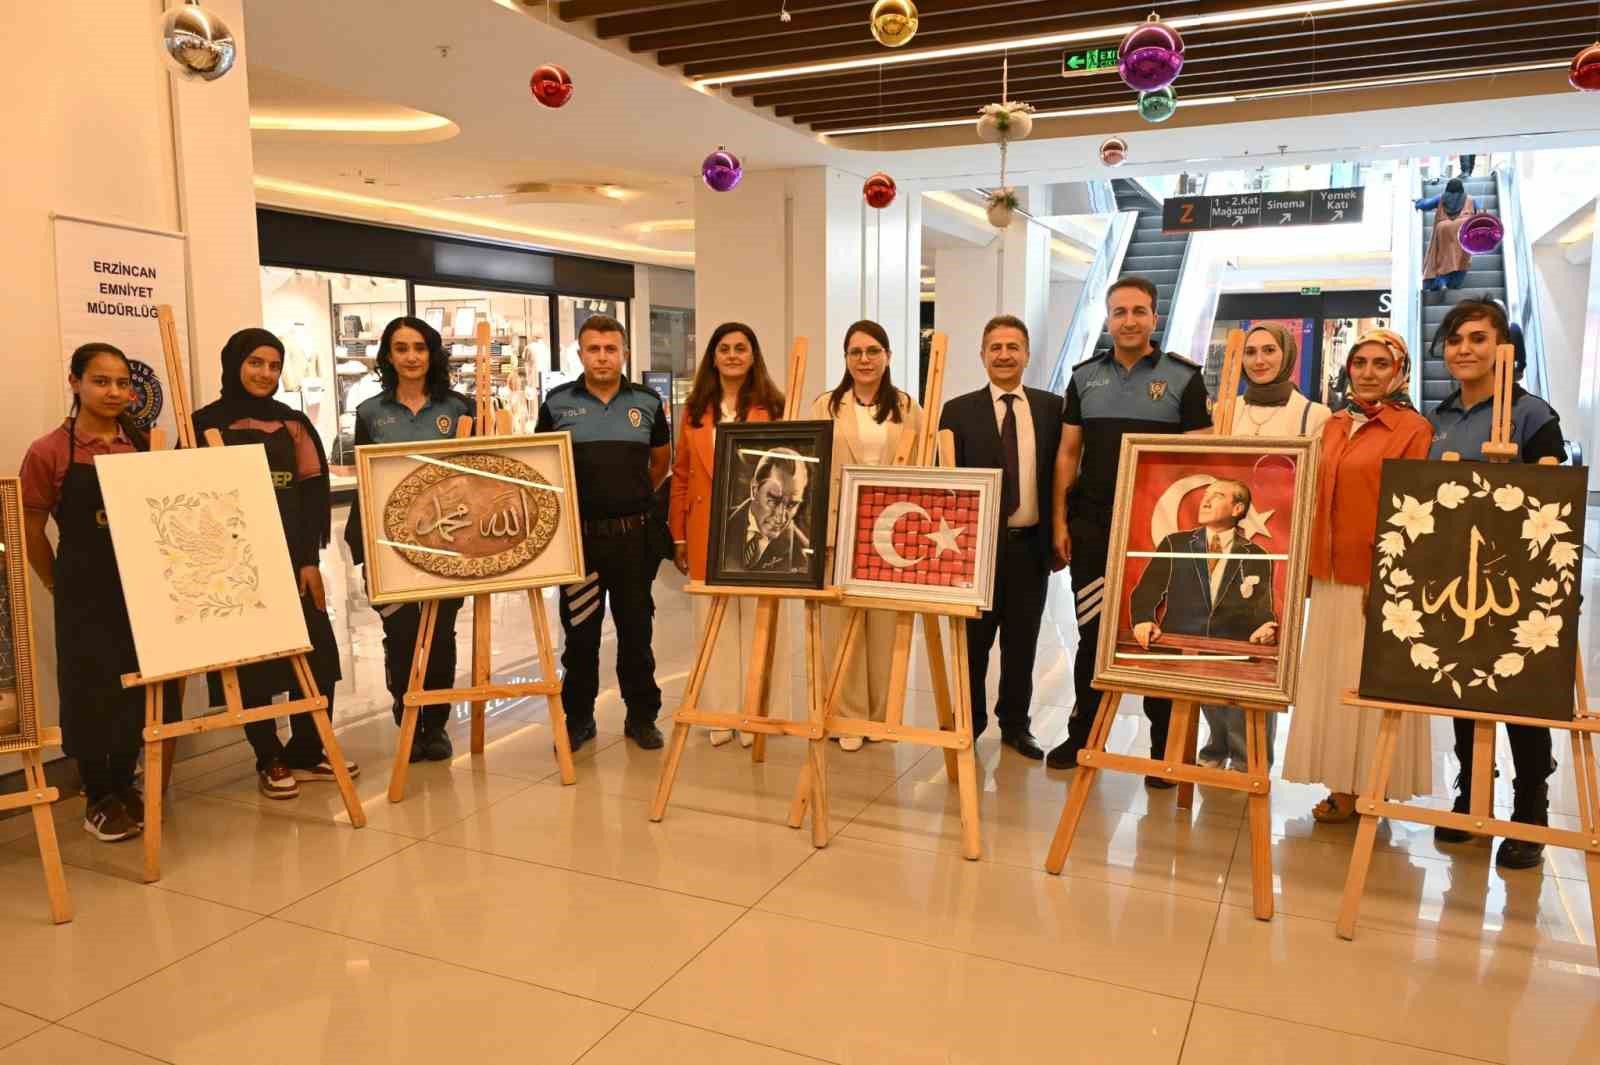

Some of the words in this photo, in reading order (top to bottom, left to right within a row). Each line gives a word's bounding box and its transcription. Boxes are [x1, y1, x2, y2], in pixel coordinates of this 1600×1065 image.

[1231, 195, 1258, 206] 2.Kat
[1320, 190, 1357, 200] Yemek
[1267, 200, 1305, 210] Sinema
[1327, 201, 1348, 210] Katı
[1179, 203, 1194, 224] Z
[1212, 206, 1259, 218] Mağazalar
[93, 260, 156, 279] ERZİNCAN
[99, 282, 153, 298] EMNİYET
[87, 301, 159, 318] MÜDÜRLÜĞ
